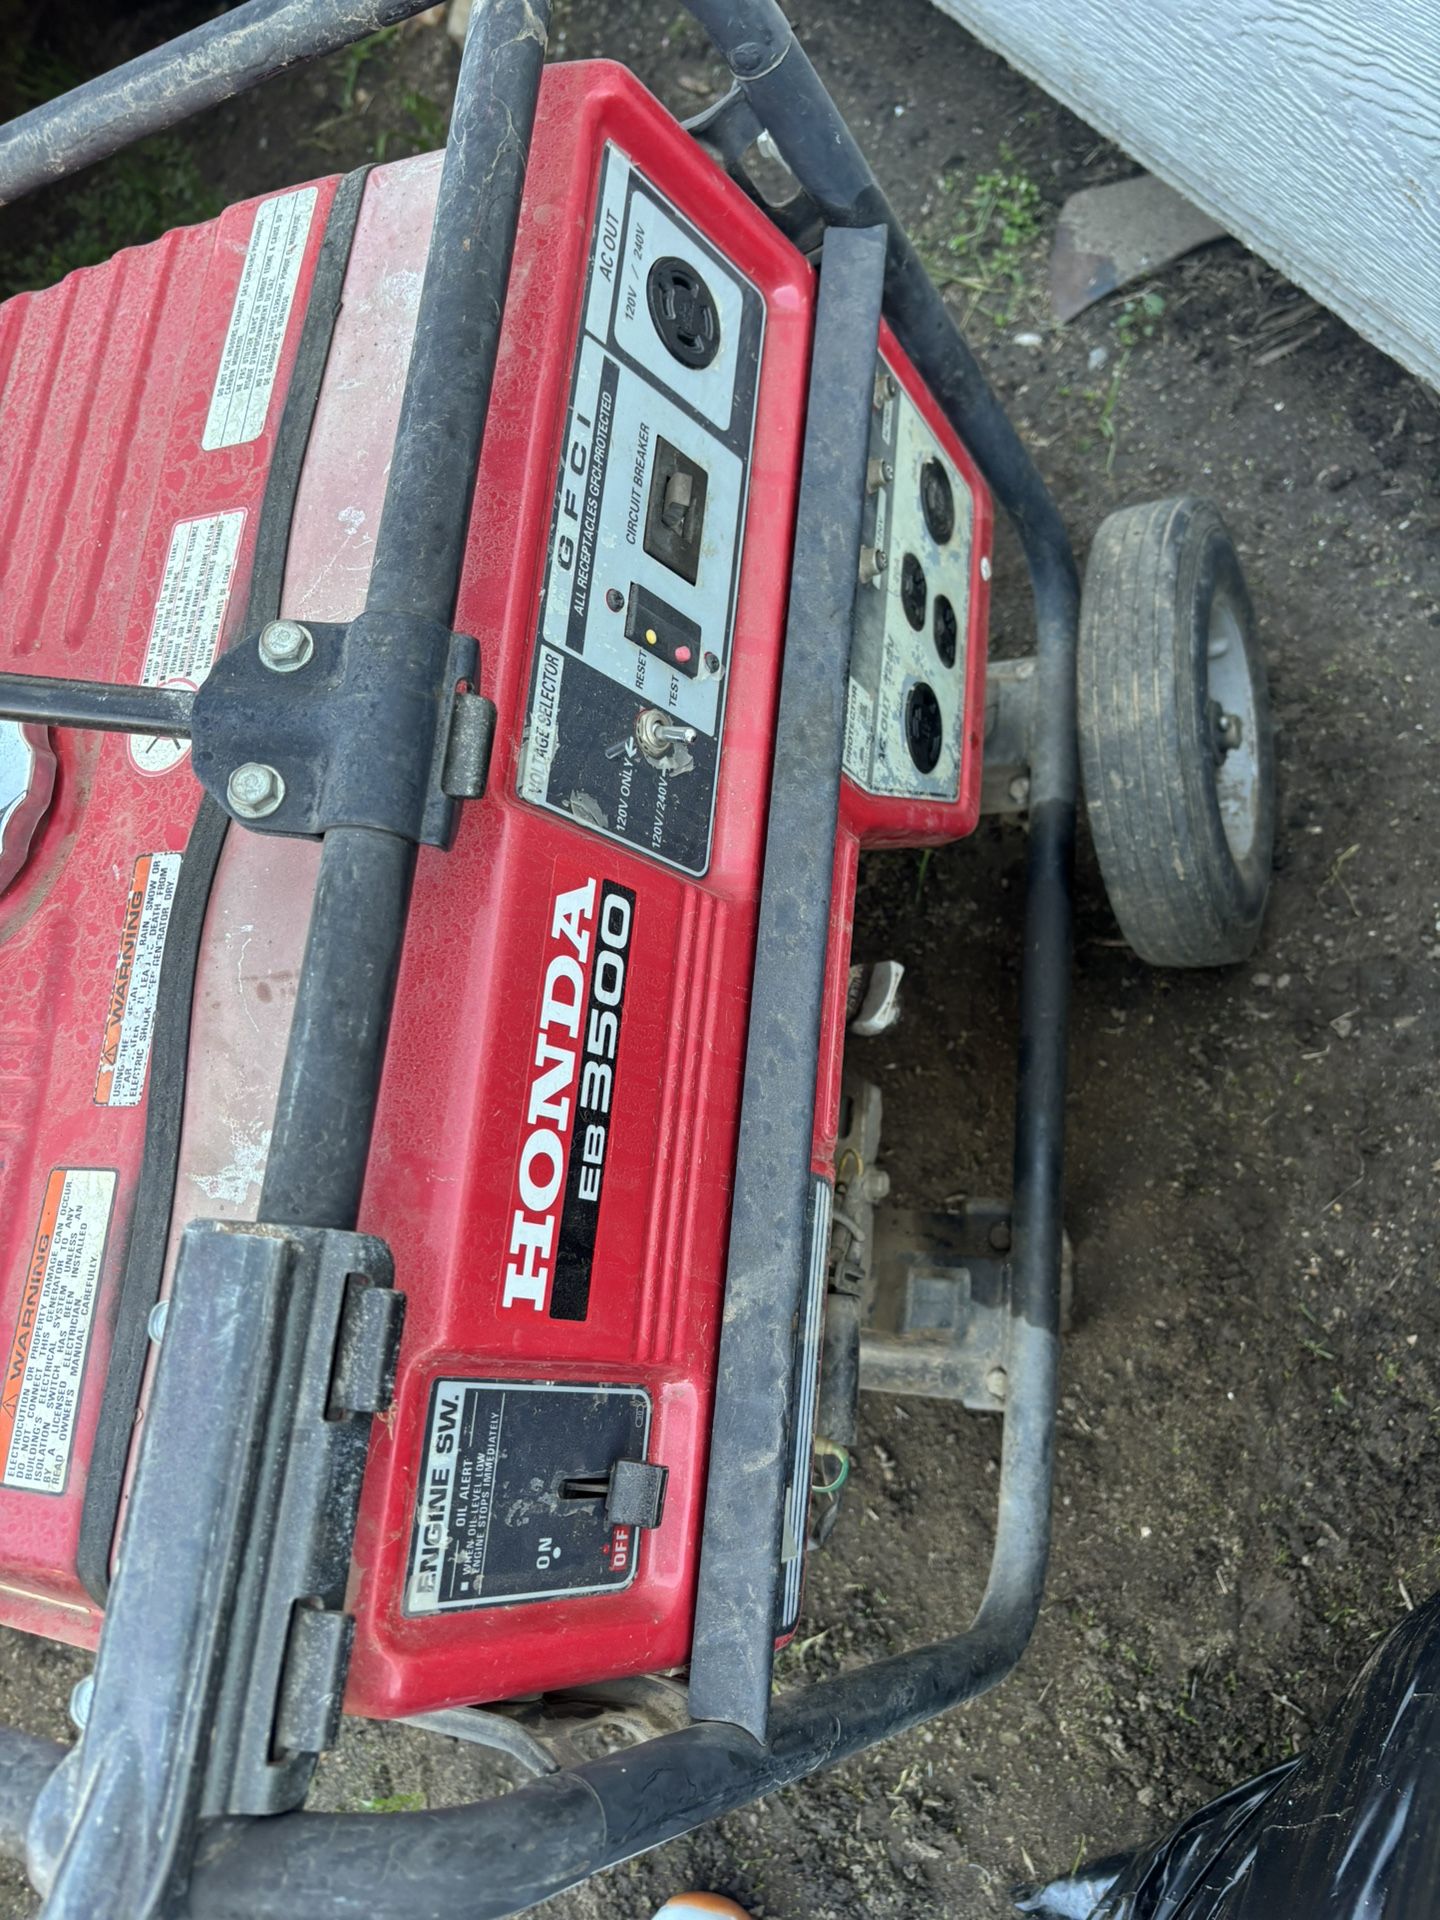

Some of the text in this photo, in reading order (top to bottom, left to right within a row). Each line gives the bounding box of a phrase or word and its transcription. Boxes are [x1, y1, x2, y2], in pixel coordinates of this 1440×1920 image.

[599, 209, 620, 283] AC OUT
[625, 286, 637, 321] 120V
[633, 223, 644, 260] 240V
[574, 392, 612, 616] ALL RECEPTACLES GFCI-PROTECTED
[626, 424, 650, 545] CIRCUIT BREAKER
[529, 654, 560, 795] VOLTAGE SELECTOR
[636, 650, 647, 688] RESET
[670, 676, 680, 707] TEST
[845, 683, 857, 763] PROTECTOR
[616, 758, 634, 832] 120V ONLY
[652, 778, 668, 849] 120V/240V
[110, 890, 143, 1026] WARNING
[148, 903, 160, 935] DEATH
[113, 1064, 125, 1096] USING
[119, 1038, 130, 1057] THE
[144, 879, 157, 910] SNOW
[151, 860, 160, 873] OR
[502, 876, 597, 1312] HONDA
[6, 1387, 31, 1477] ELECTROCUTION
[25, 1366, 35, 1381] OR
[30, 1303, 47, 1359] PROPERTY
[42, 1250, 58, 1296] DAMAGE
[53, 1222, 64, 1243] CAN
[9, 1233, 49, 1381] WARNING
[15, 1207, 74, 1478] DO NOT CONNECT THIS GENERATOR TO ANY
[24, 1205, 82, 1479] BUILDING'S ELECTRICAL SYSTEM UNLESS AN
[33, 1222, 87, 1481] ISOLATION SWITCH HAS BEEN INSTALLED
[42, 1468, 52, 1482] BY
[47, 1447, 55, 1455] A
[51, 1380, 67, 1433] LICENSED
[50, 1454, 63, 1484] READ
[58, 1388, 75, 1440] OWNER'S
[69, 1327, 85, 1376] MANUAL
[416, 1394, 459, 1594] ENGINE SW.
[454, 1459, 473, 1527] OIL ALERT
[462, 1452, 486, 1575] WHEN OIL LEVEL LOW
[477, 1490, 490, 1527] STOPS
[613, 1528, 628, 1567] OFF
[471, 1531, 486, 1574] ENGINE
[535, 1536, 552, 1569] ON
